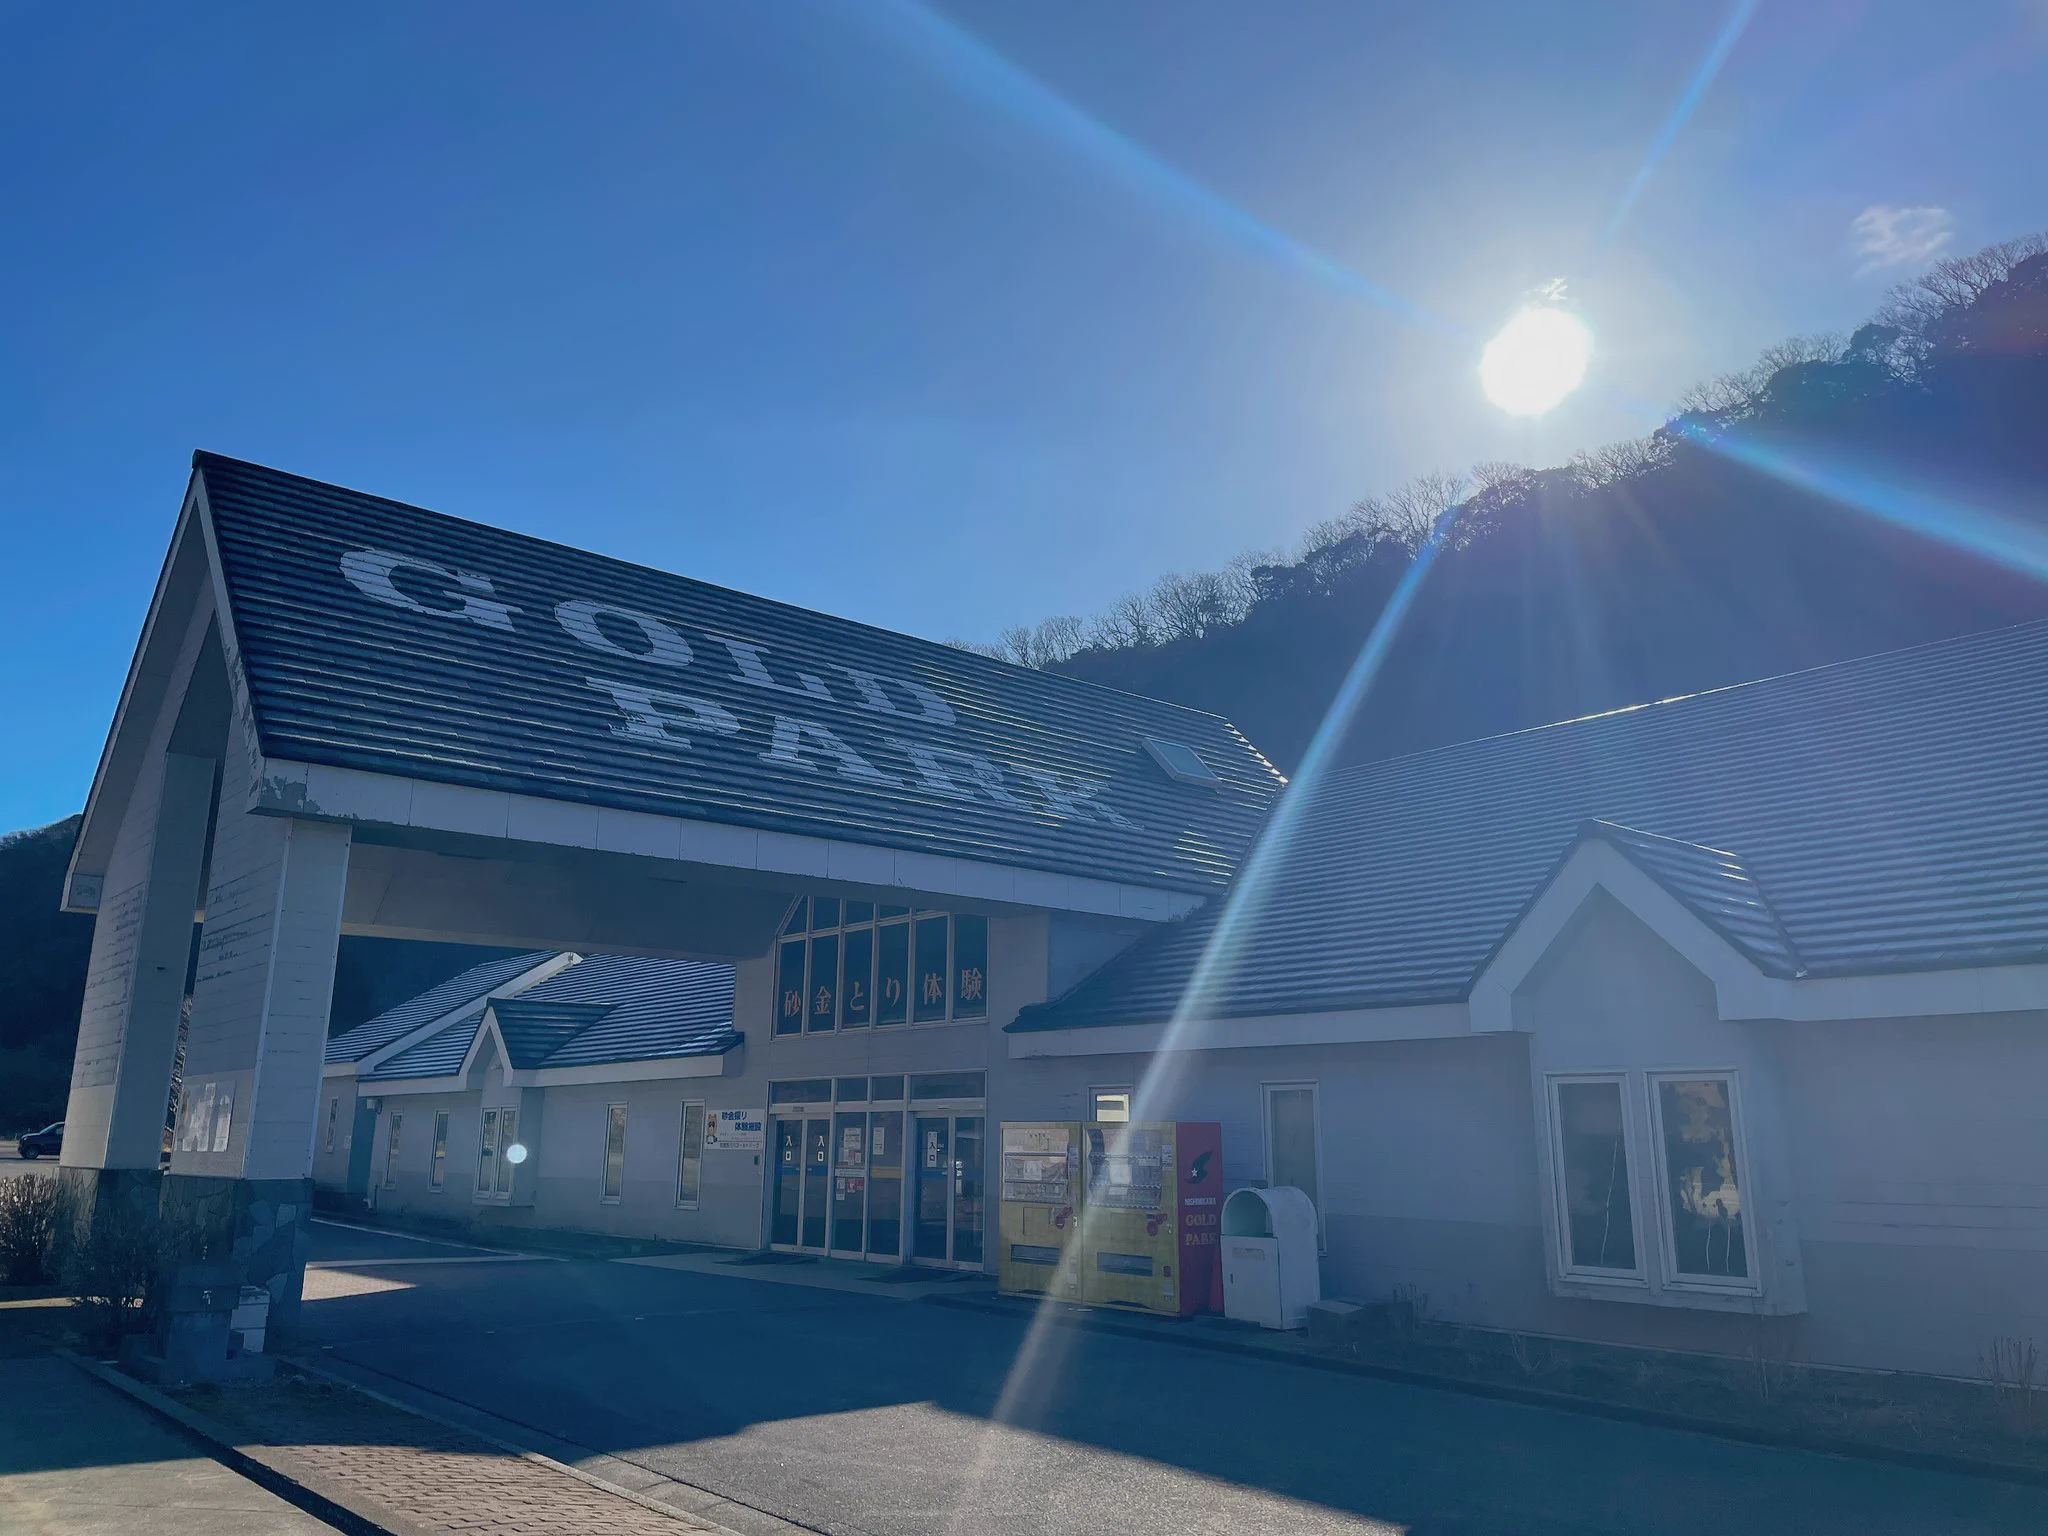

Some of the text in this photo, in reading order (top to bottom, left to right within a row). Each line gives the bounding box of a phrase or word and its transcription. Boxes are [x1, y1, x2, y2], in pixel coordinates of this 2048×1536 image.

[339, 547, 956, 727] GOLD
[584, 676, 1147, 832] PARK
[783, 967, 983, 1018] 砂金とり体験
[785, 1135, 793, 1161] 入口
[817, 1135, 825, 1162] 入口
[928, 1141, 936, 1161] 入口
[1185, 1213, 1217, 1227] GOLD
[1184, 1232, 1217, 1246] PARK
